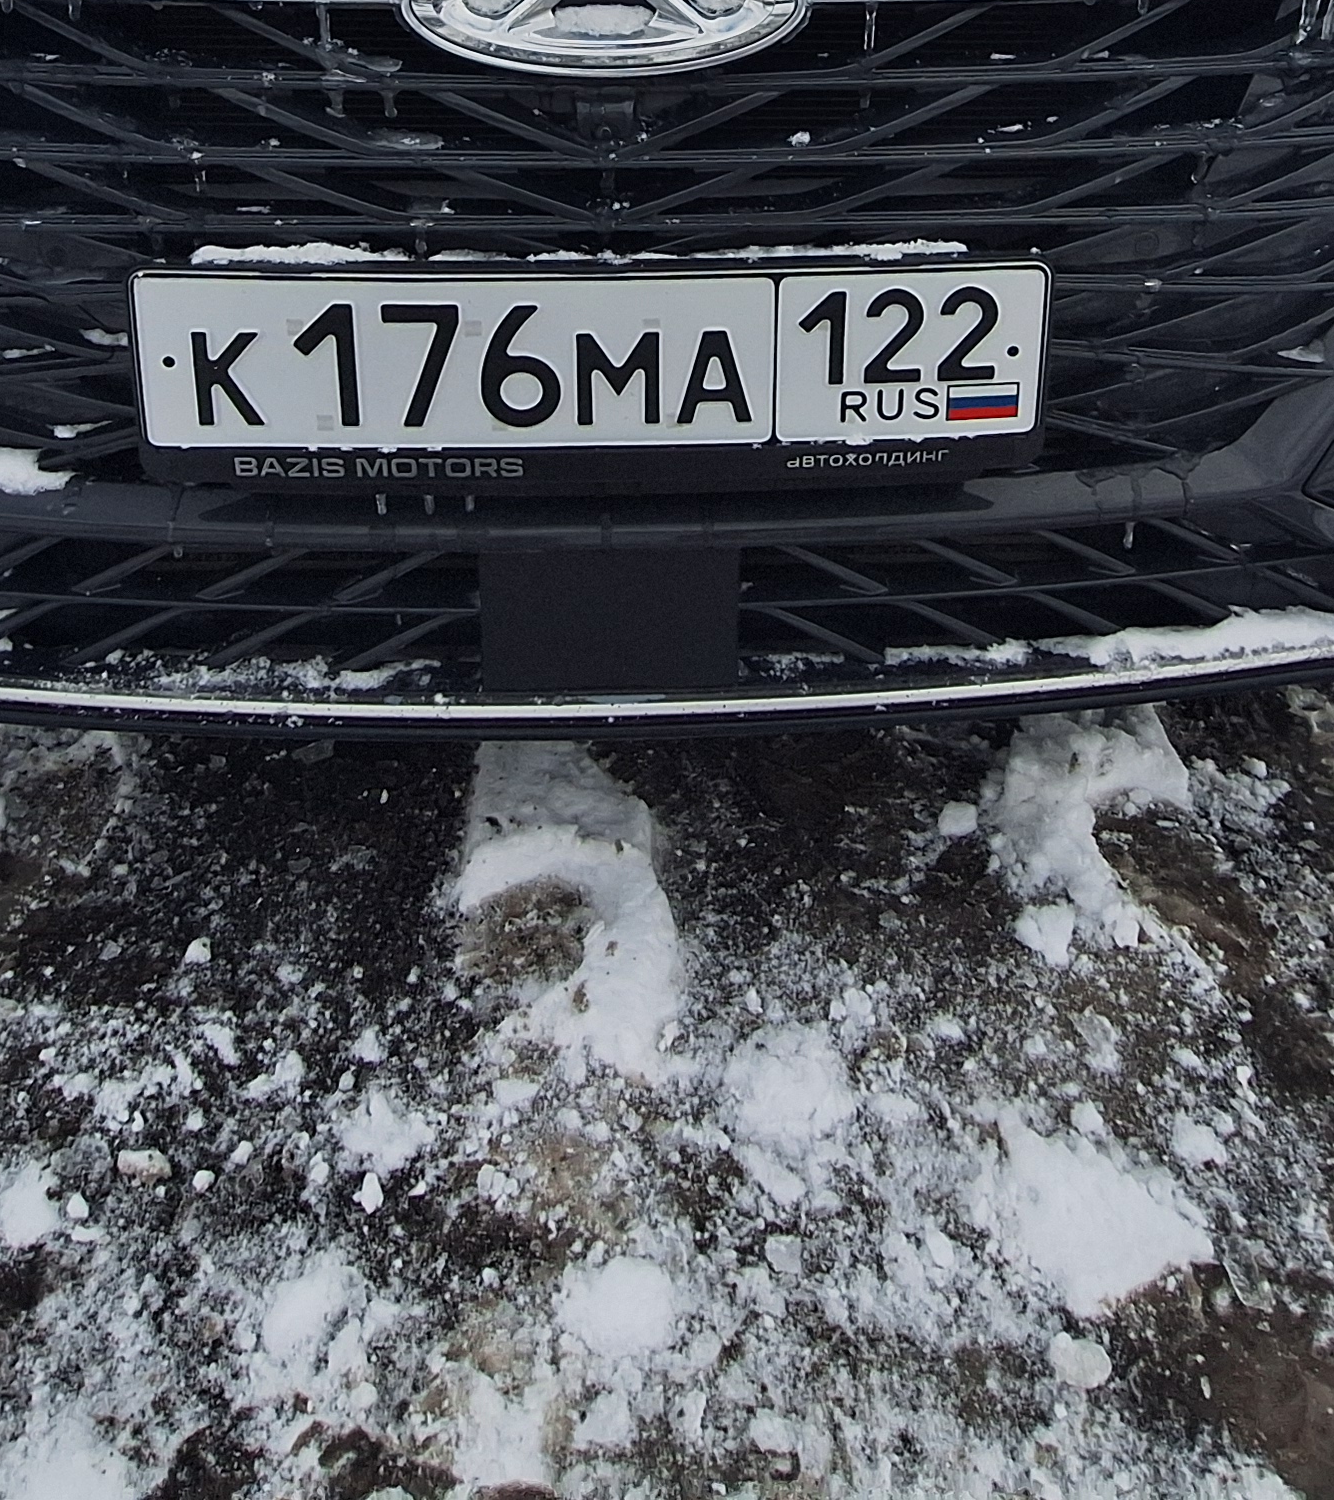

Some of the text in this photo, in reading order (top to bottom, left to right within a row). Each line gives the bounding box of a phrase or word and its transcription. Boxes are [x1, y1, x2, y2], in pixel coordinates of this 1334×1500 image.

[189, 285, 999, 428] К176МА 122
[839, 387, 940, 423] RUS
[233, 456, 524, 478] BAZIS MOTORS
